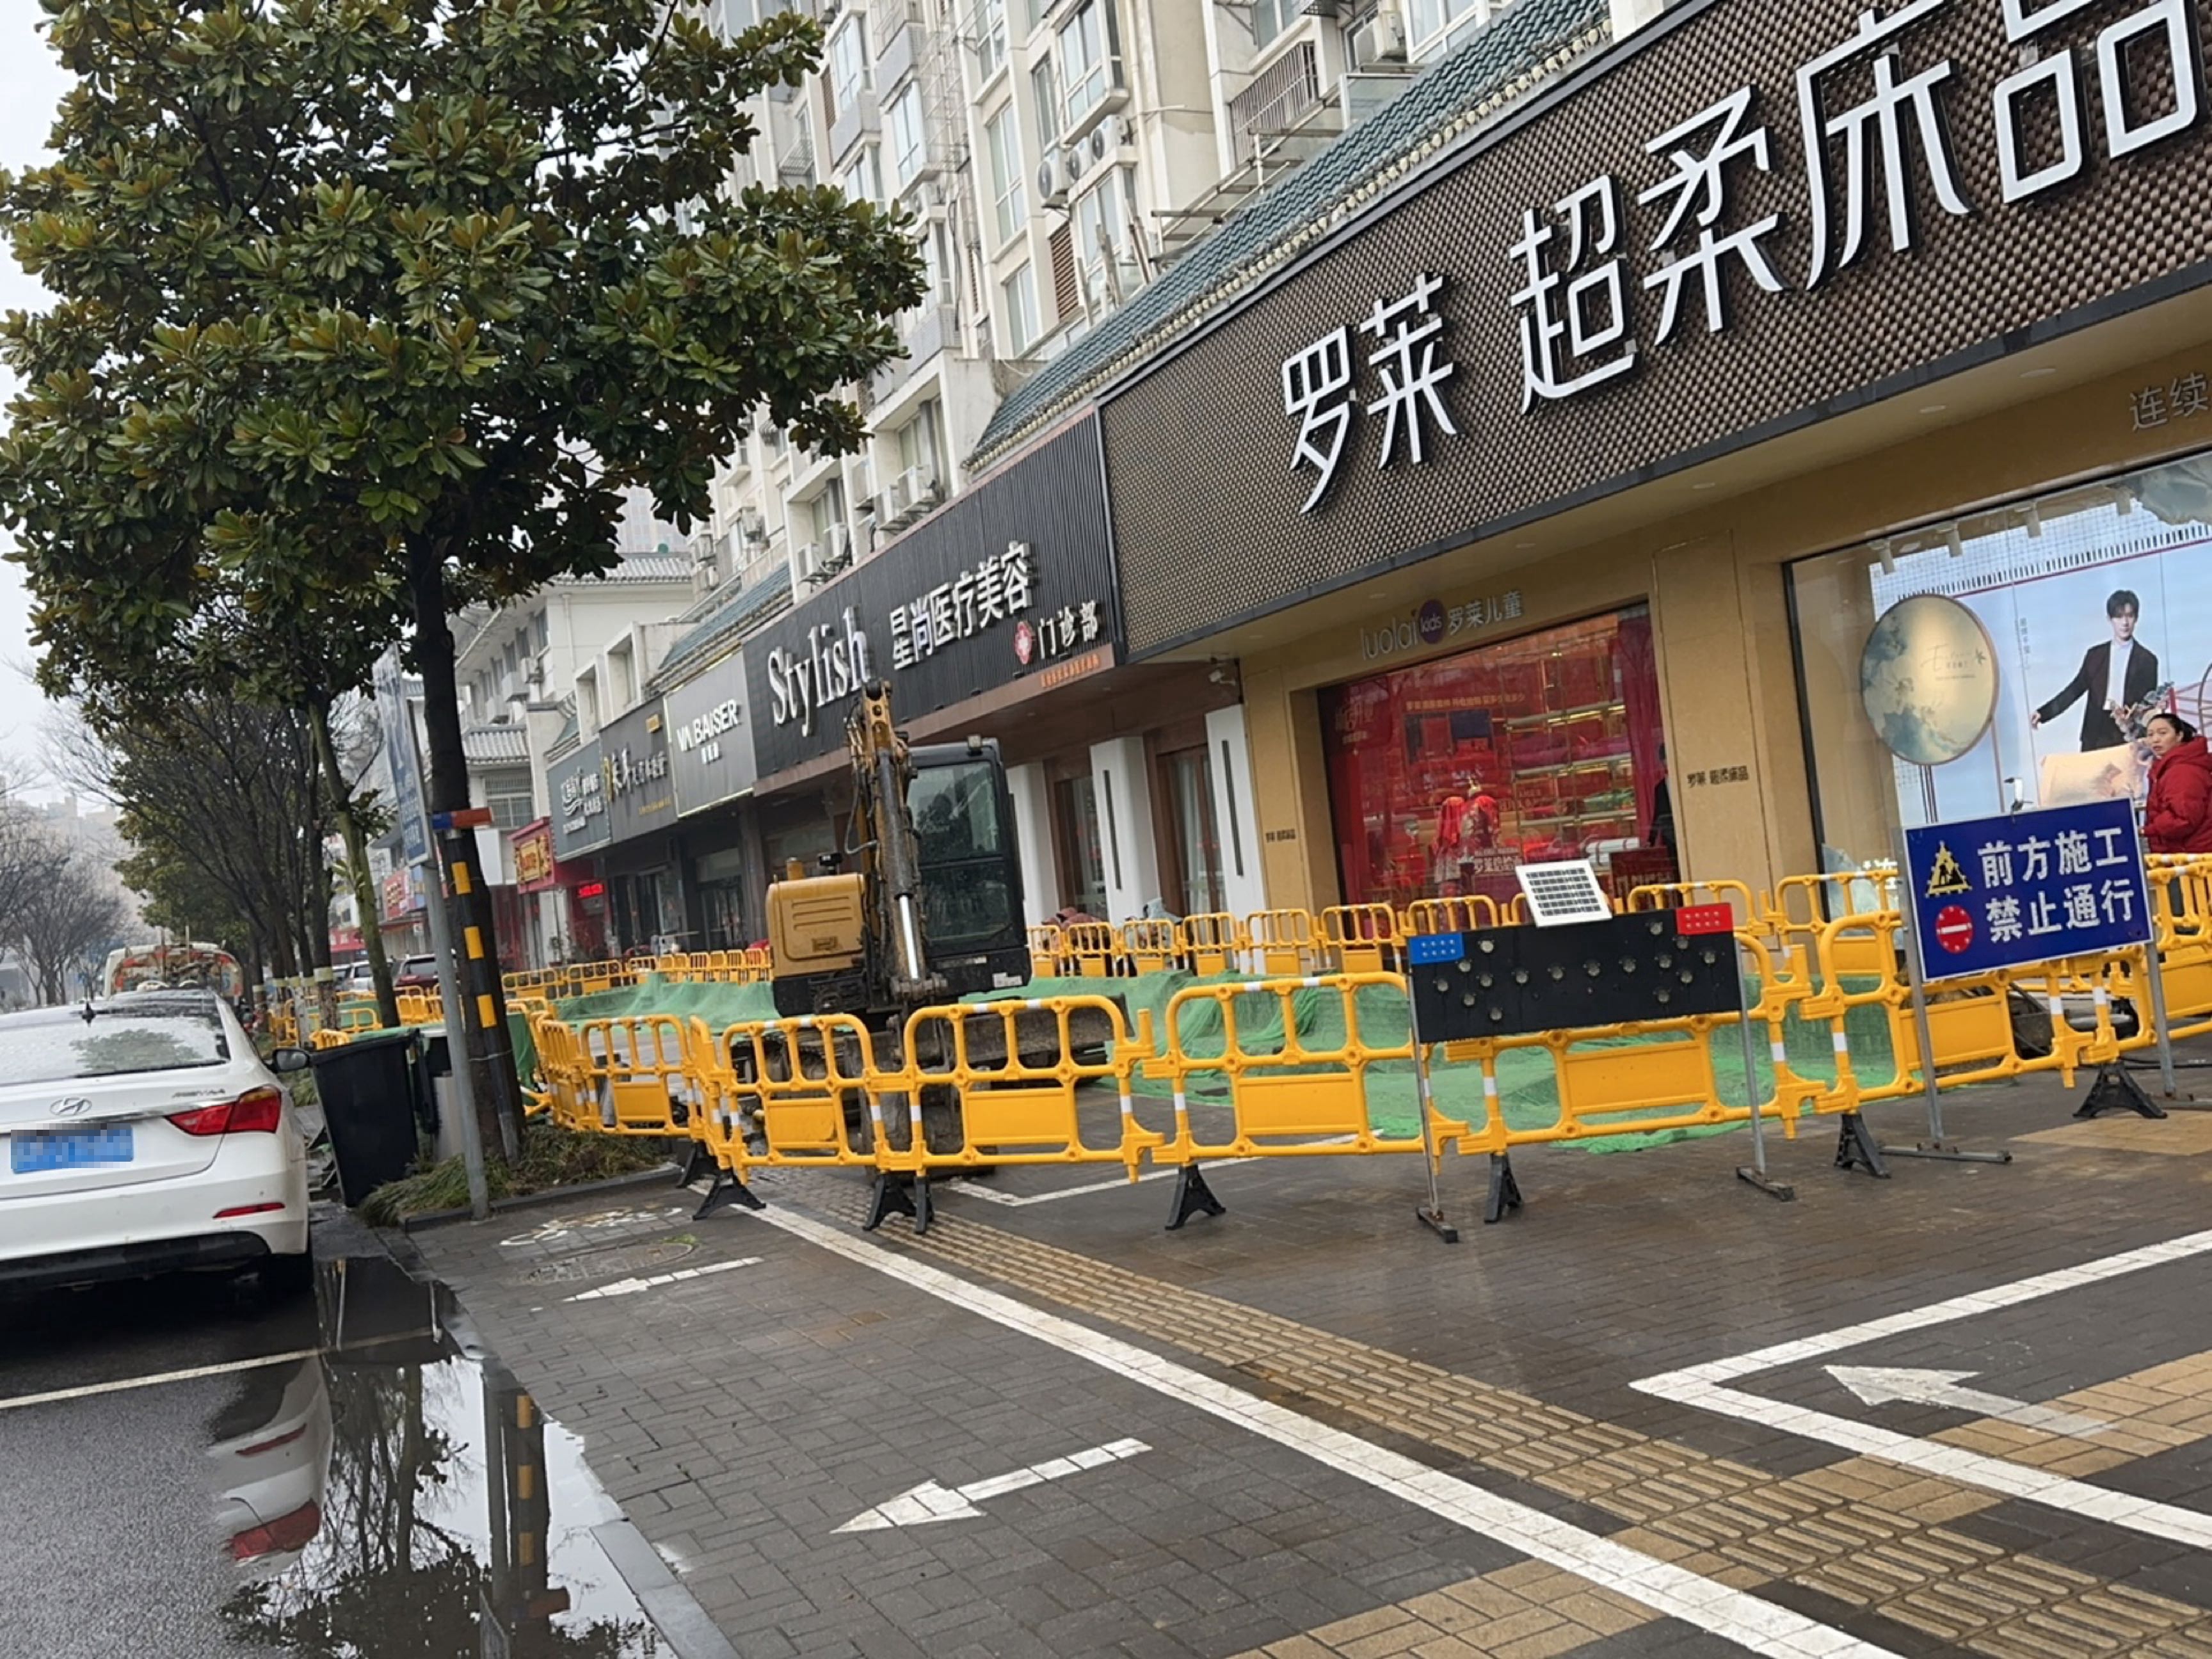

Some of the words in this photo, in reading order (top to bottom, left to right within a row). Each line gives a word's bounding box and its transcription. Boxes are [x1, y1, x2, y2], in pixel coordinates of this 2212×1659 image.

[1283, 273, 1458, 513] 罗莱
[1511, 0, 2198, 415] 超柔床品
[2129, 372, 2208, 431] 连续
[889, 540, 1035, 670] 星尚医疗美容
[1038, 600, 1099, 659] 门诊部
[1420, 613, 1443, 633] kids
[1448, 590, 1523, 636] 罗莱儿童
[768, 606, 871, 738] Stylish
[693, 698, 739, 744] BAISER
[1977, 827, 2129, 889] 前方施工
[1985, 879, 2135, 944] 禁止通行
